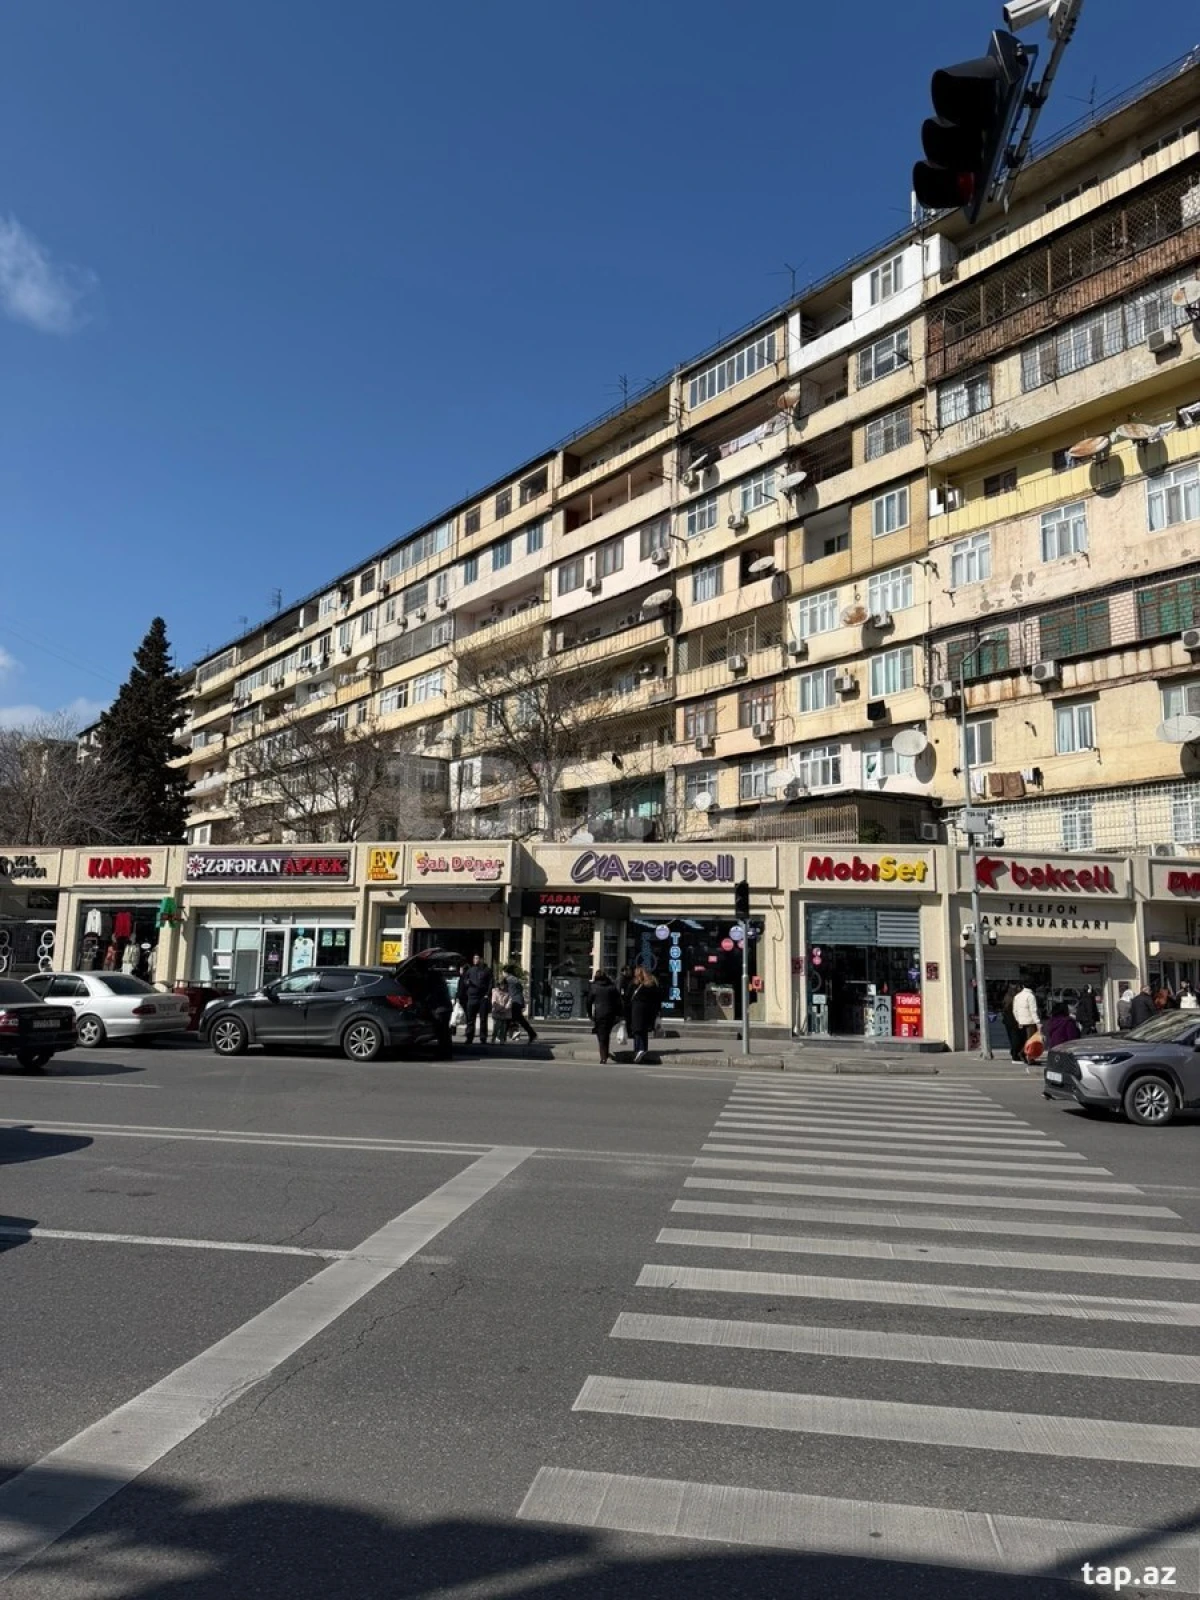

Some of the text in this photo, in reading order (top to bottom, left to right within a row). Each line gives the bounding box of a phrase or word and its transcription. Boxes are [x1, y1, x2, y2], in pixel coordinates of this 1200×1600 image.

[88, 857, 151, 878] KAPRIS
[204, 857, 345, 874] ZƏFƏRAN APTEK
[601, 854, 733, 881] Azercell
[1011, 862, 1114, 889] bakcell
[539, 905, 581, 915] STORE
[1008, 903, 1078, 914] TELEFON
